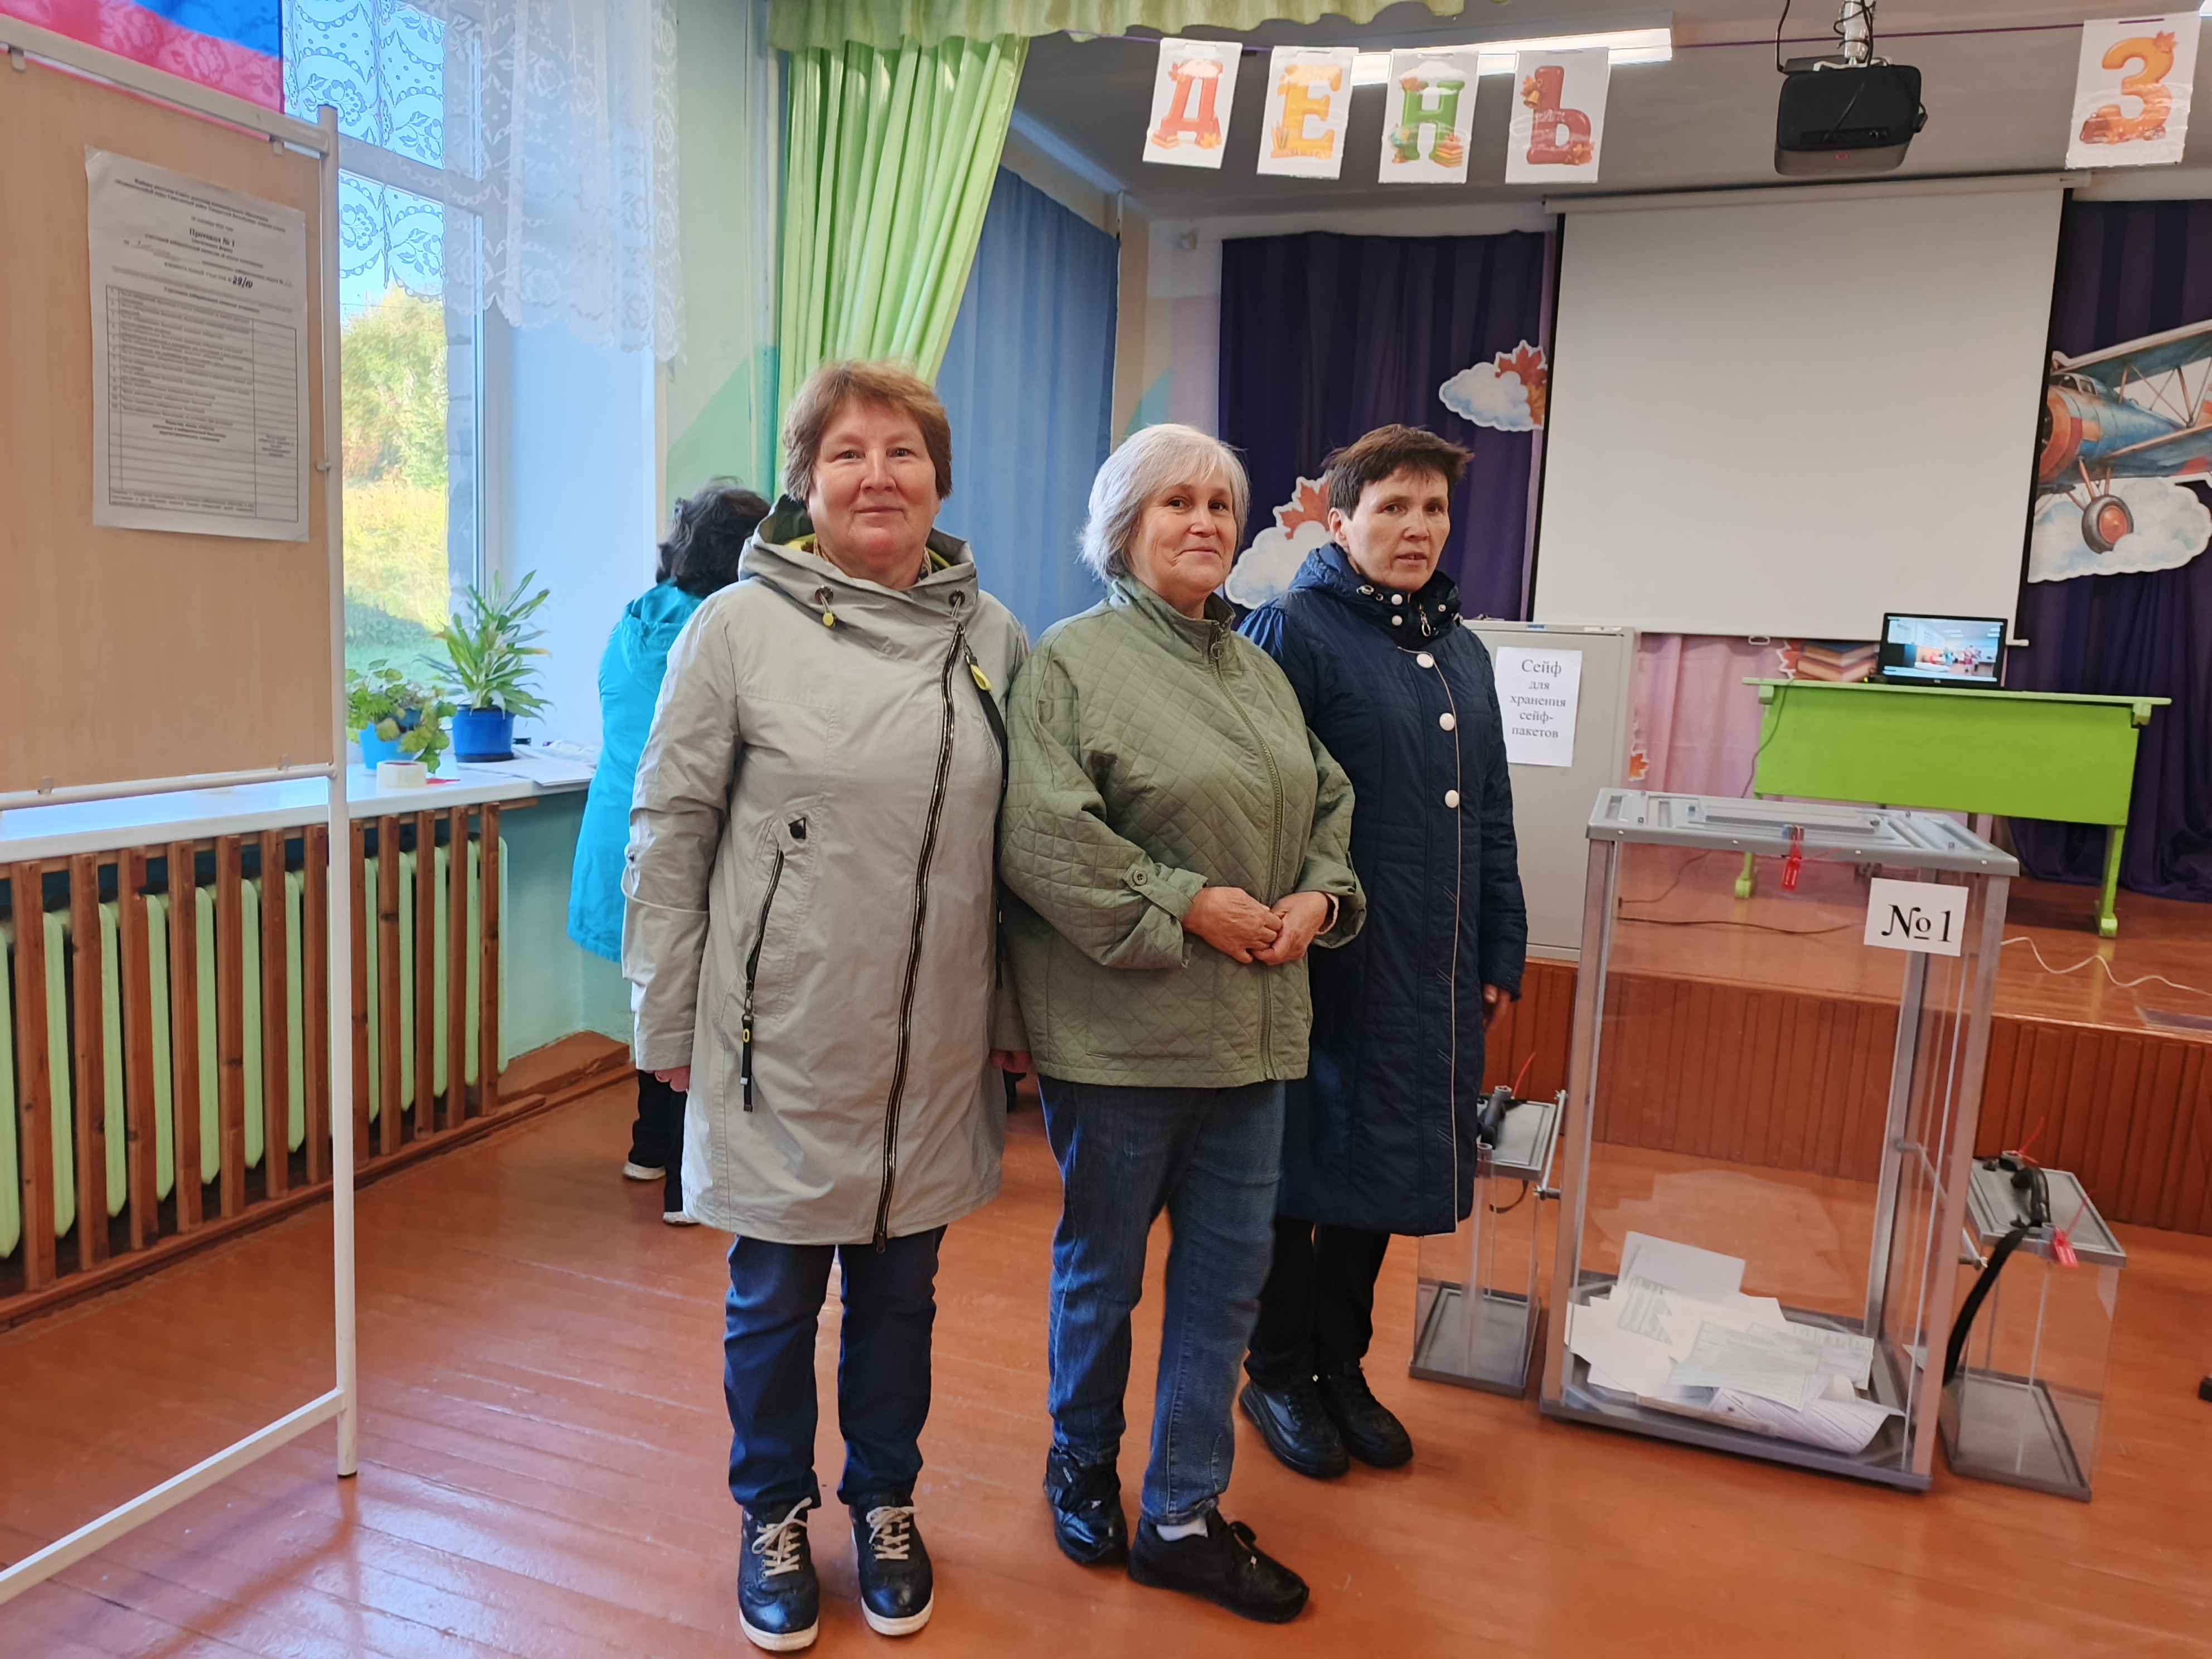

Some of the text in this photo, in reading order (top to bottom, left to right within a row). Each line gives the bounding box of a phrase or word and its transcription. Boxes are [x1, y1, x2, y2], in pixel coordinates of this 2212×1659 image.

[1160, 60, 1593, 166] ДЕНЬ
[1521, 659, 1562, 678] Сейф
[1529, 681, 1550, 691] для
[1510, 695, 1566, 707] хранения
[1519, 710, 1554, 724] сейф-
[1511, 726, 1559, 738] пакетов
